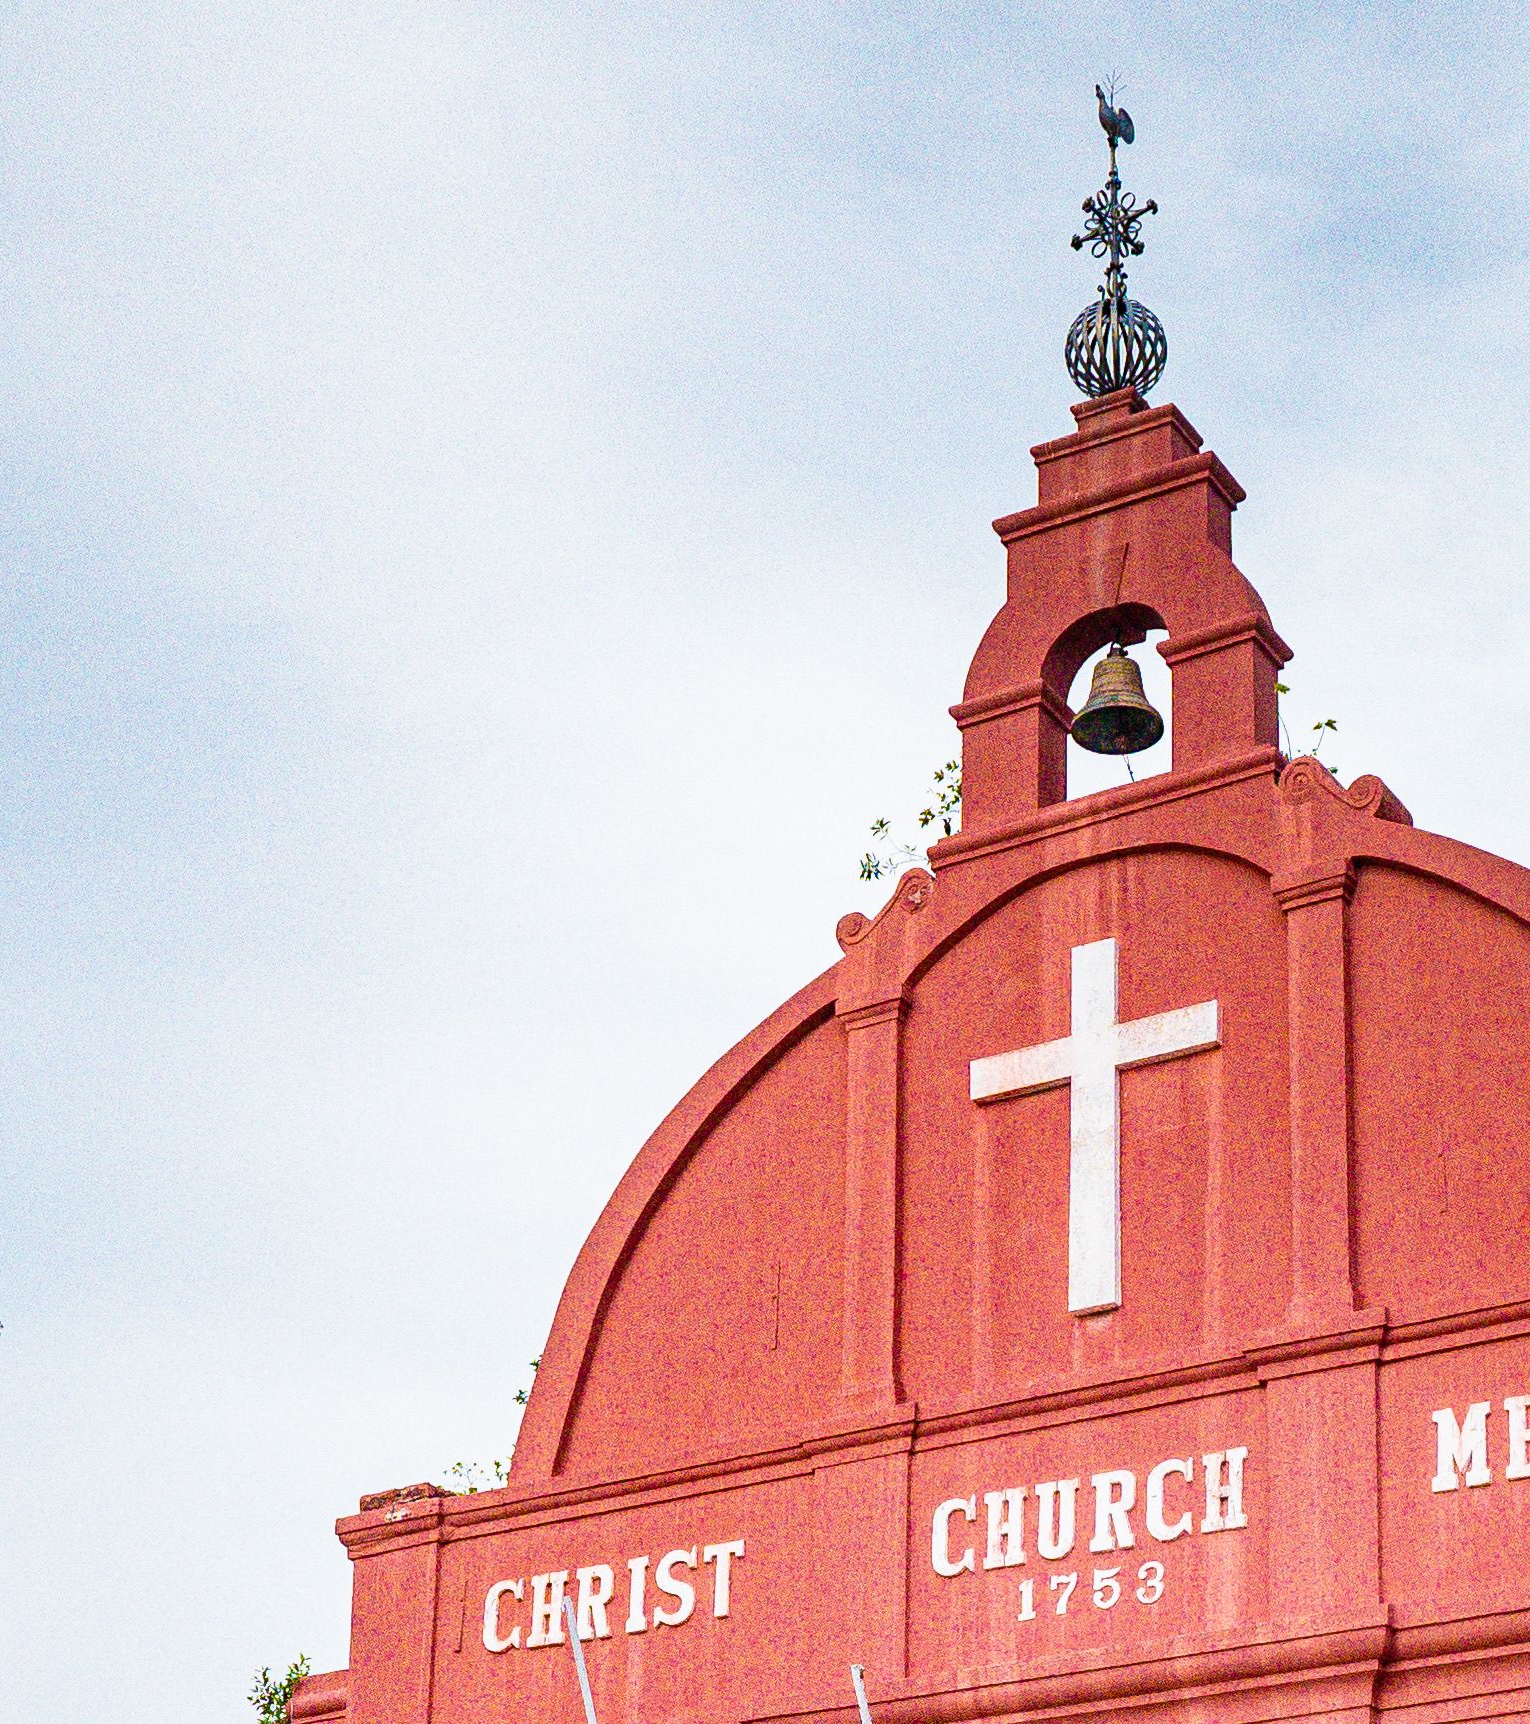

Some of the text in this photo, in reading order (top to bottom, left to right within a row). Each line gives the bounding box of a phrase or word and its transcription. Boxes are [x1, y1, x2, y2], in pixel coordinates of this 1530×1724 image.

[482, 1539, 745, 1653] CHRIST
[931, 1446, 1248, 1577] CHURCH
[1018, 1560, 1166, 1622] 1753
